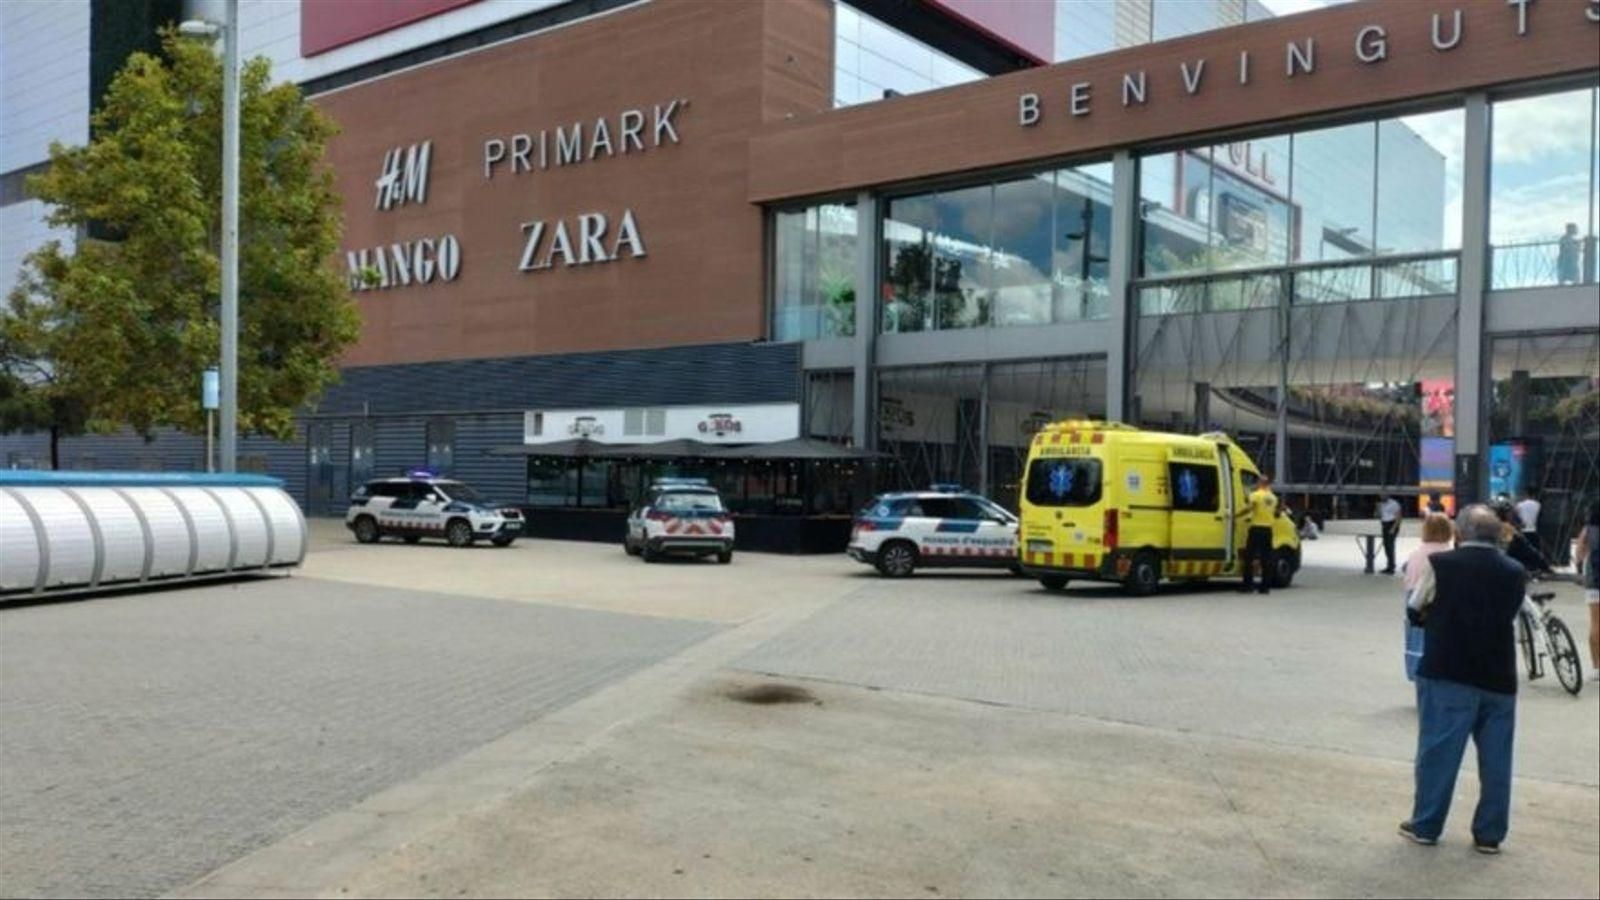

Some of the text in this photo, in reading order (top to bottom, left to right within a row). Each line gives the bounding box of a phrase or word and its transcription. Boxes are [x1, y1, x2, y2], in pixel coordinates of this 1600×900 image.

[1018, 0, 1599, 127] BENVINGUT
[484, 99, 679, 179] PRIMARK
[375, 140, 432, 210] H&M
[347, 233, 461, 292] MANGO
[518, 207, 646, 272] ZARA
